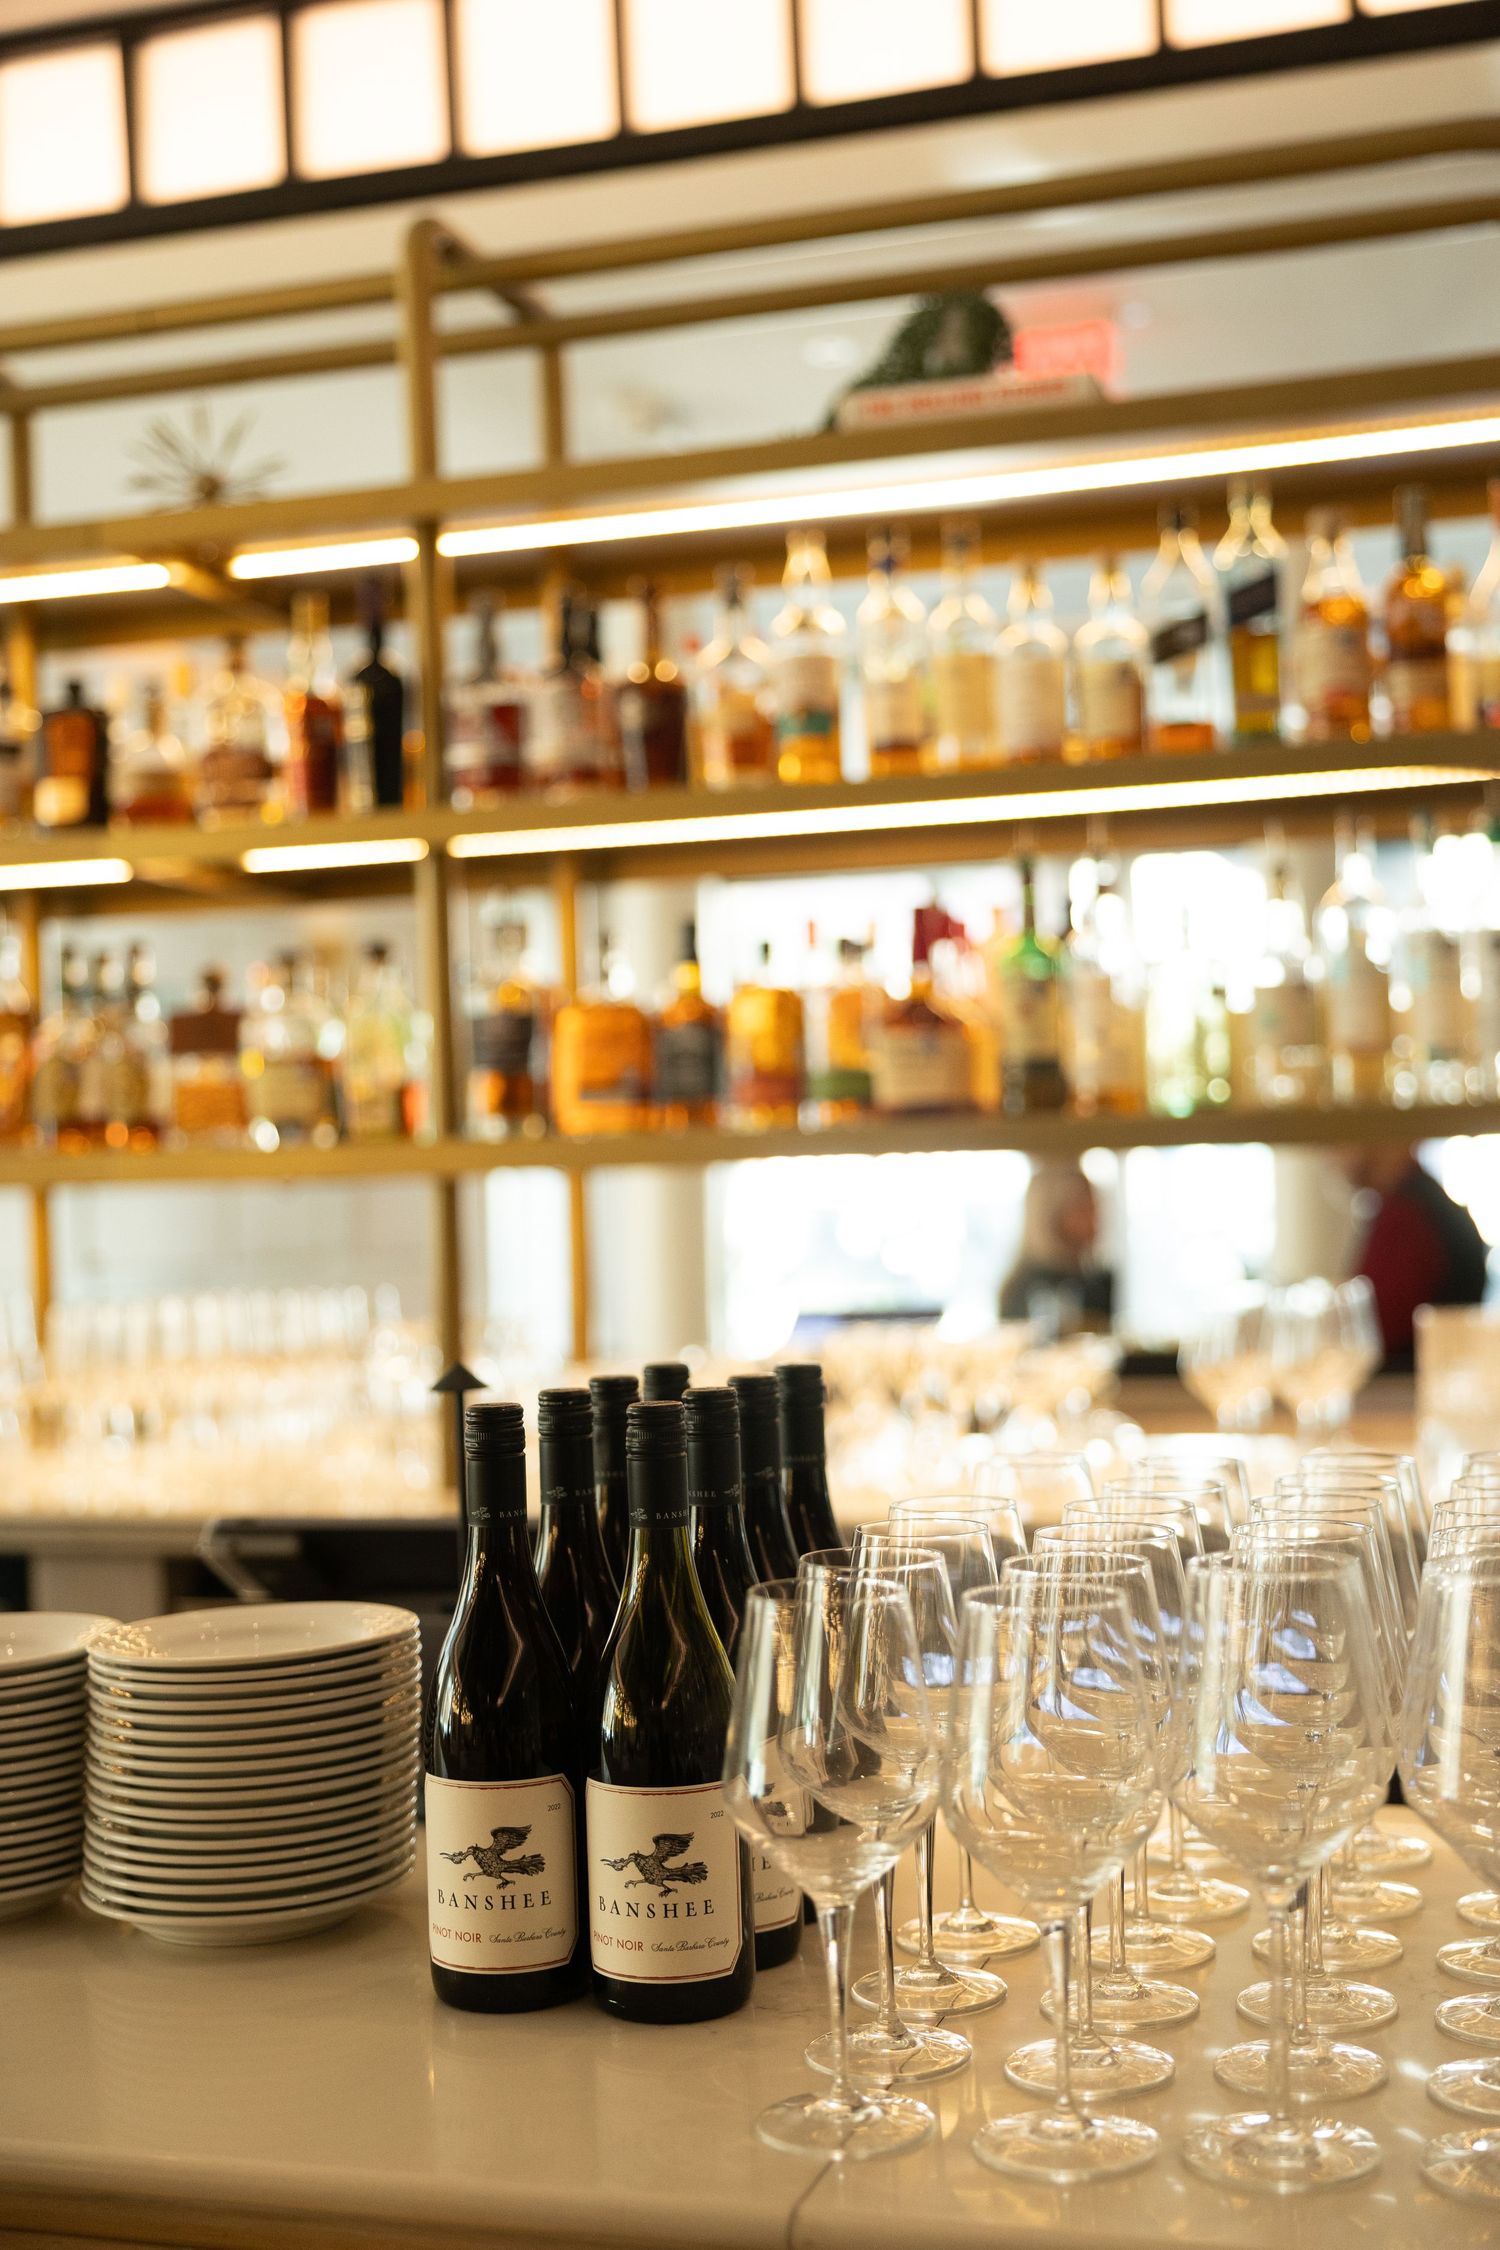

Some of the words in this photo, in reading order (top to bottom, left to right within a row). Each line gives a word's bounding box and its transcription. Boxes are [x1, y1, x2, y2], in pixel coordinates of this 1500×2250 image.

[710, 1810, 724, 1819] 2022
[438, 1889, 552, 1911] BANSHEE
[599, 1895, 714, 1919] BANSHEE
[432, 1922, 452, 1940] PINOT
[455, 1931, 482, 1944] NOIR
[488, 1933, 512, 1944] Santa
[513, 1931, 543, 1943] Barbara
[543, 1927, 567, 1940] County
[593, 1929, 613, 1947] PINOT
[616, 1938, 644, 1952] NOIR
[651, 1941, 675, 1952] Santa
[676, 1940, 706, 1952] Barbara
[704, 1936, 730, 1949] County
